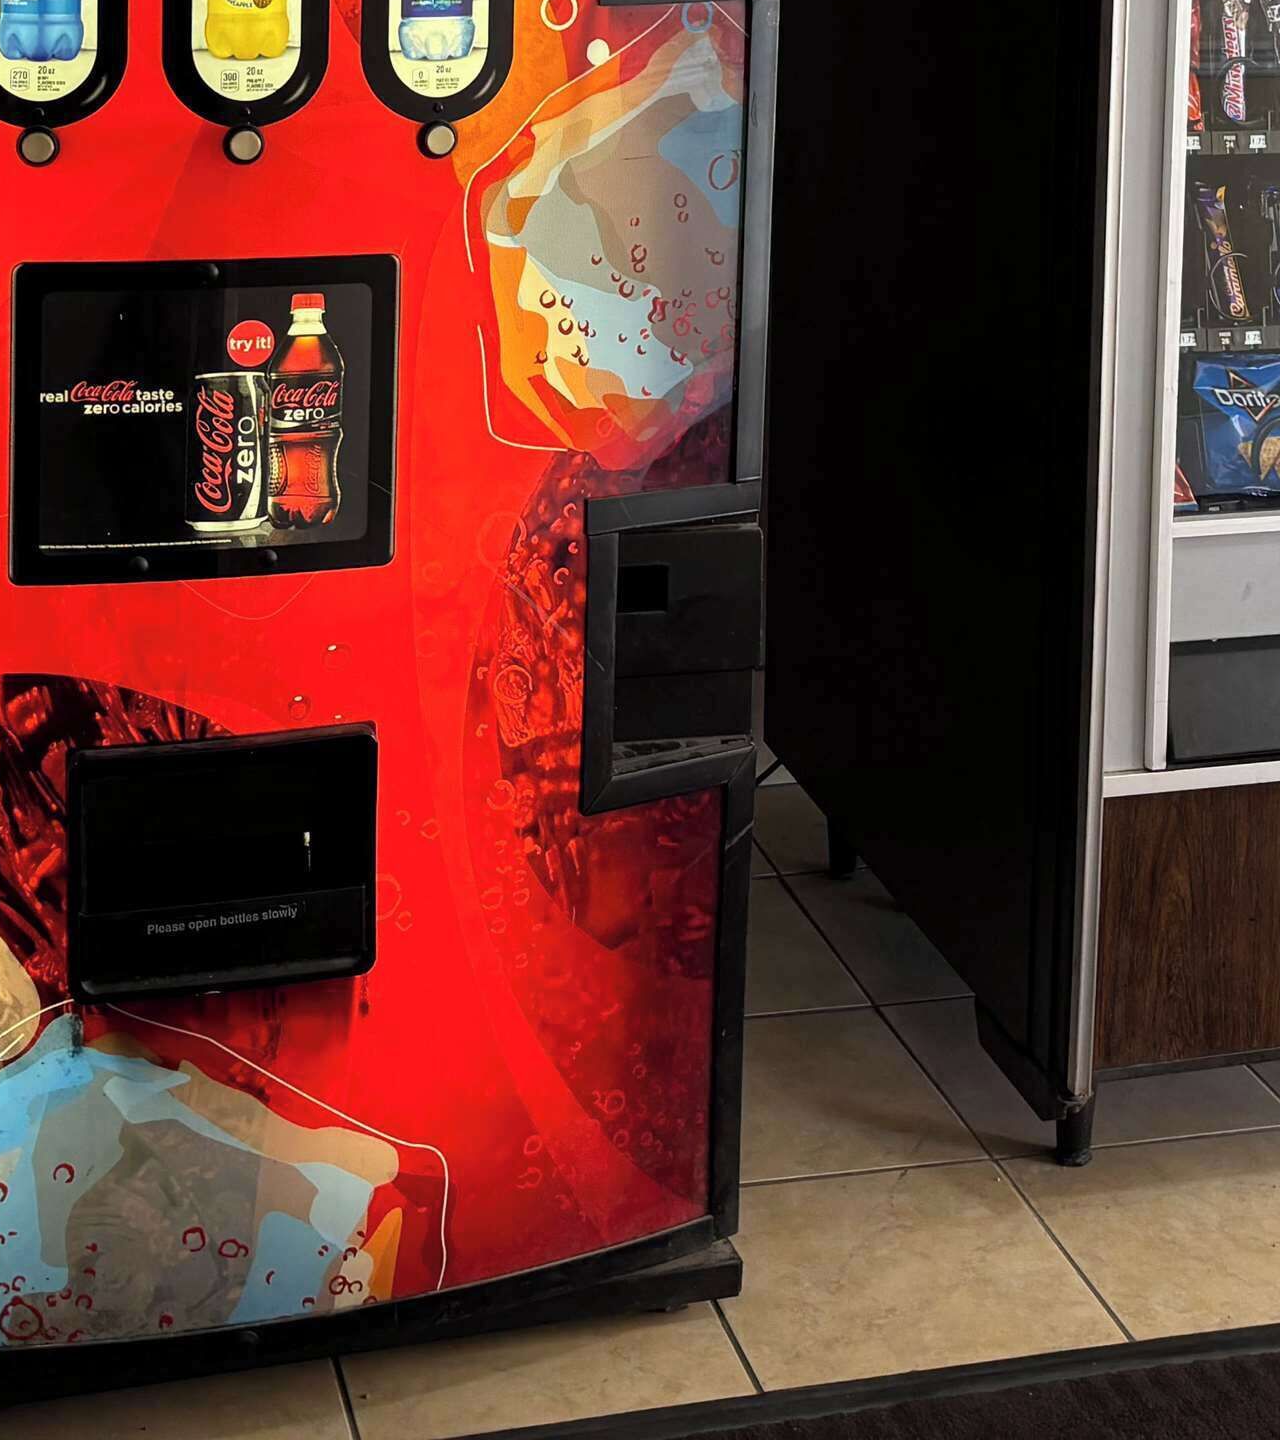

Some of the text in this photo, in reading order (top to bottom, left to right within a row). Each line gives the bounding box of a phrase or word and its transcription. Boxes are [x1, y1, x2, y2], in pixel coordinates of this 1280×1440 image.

[12, 71, 28, 80] 270
[38, 66, 47, 75] 20
[246, 67, 256, 75] 20
[436, 65, 445, 74] 20
[229, 336, 271, 351] try it!
[40, 380, 174, 403] real Coca-Cola taste
[271, 381, 339, 408] Coca-Cola
[84, 400, 183, 415] zero calories
[284, 407, 324, 421] zero
[194, 385, 234, 513] Coca-Cola
[237, 416, 255, 484] zero
[147, 906, 297, 935] Please open bottles slowly
